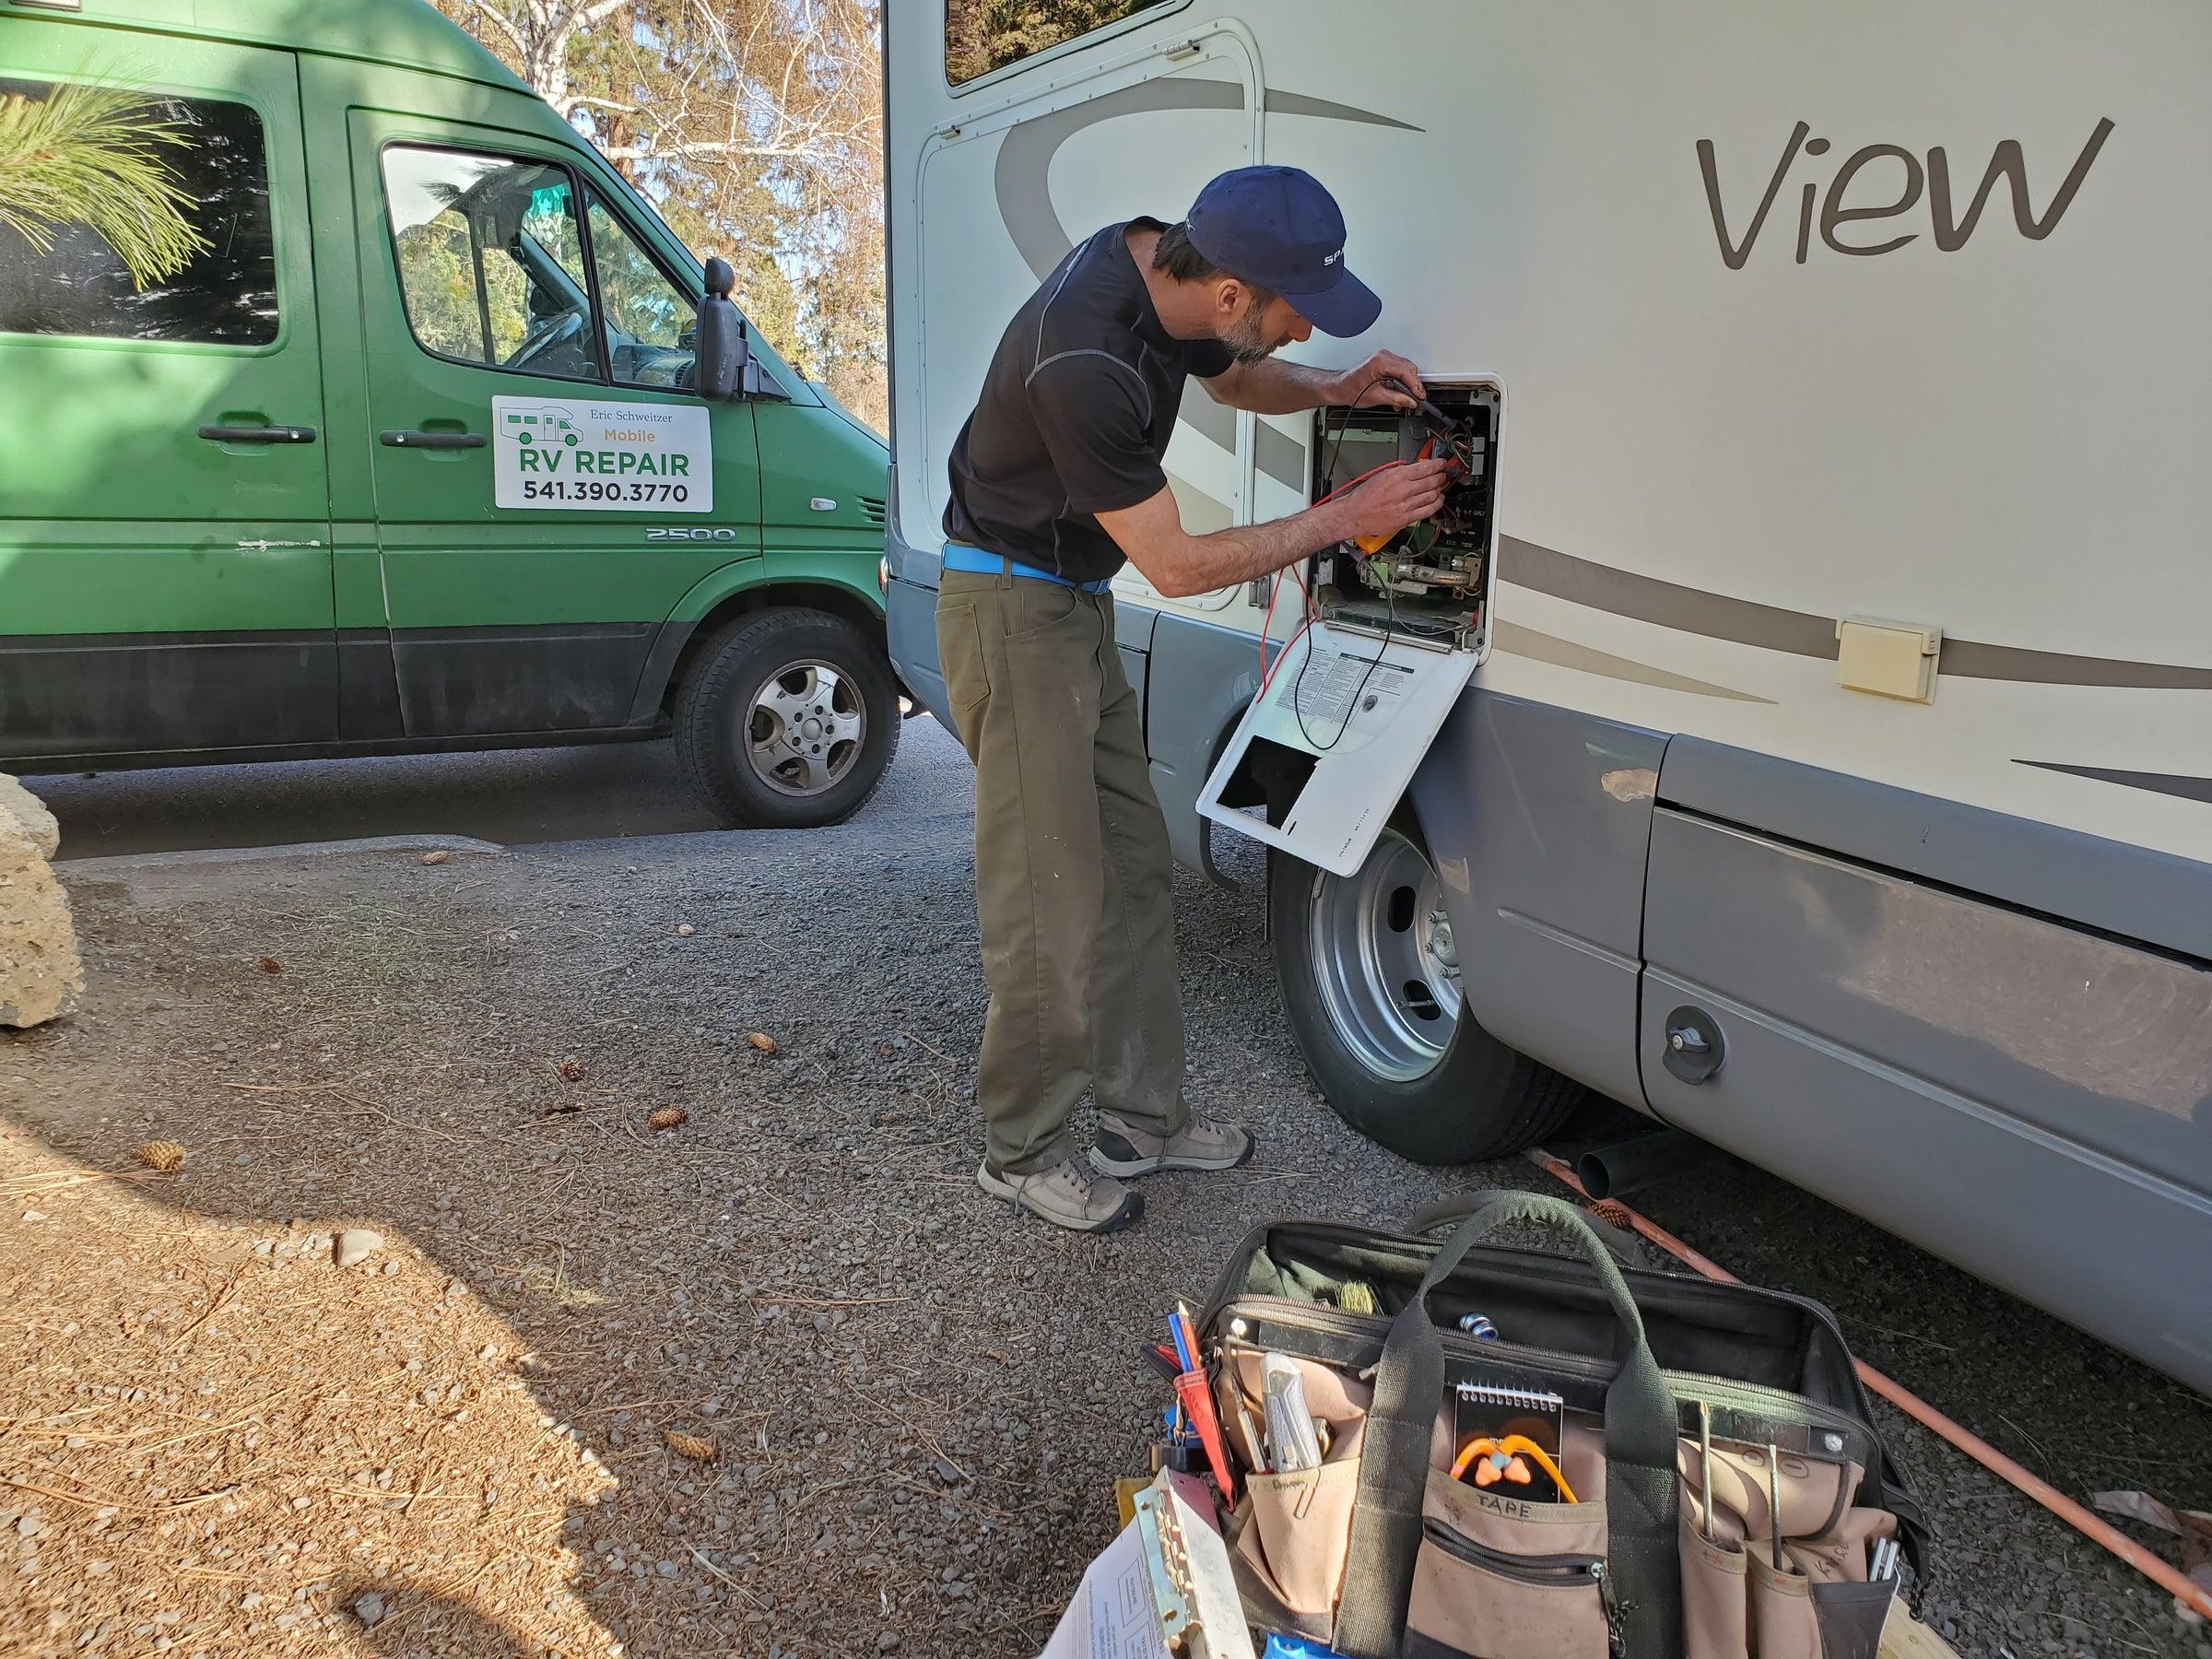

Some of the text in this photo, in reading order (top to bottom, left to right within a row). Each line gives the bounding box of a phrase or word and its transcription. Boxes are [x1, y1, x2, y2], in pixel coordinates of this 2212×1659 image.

[1696, 116, 2115, 270] View
[590, 409, 673, 423] Eric Schweitzer
[604, 428, 655, 443] Mobile
[519, 448, 689, 477] RV REPAIR
[524, 480, 688, 503] 541.390.3770
[645, 527, 736, 542] 2500
[1477, 1493, 1532, 1519] TAPE
